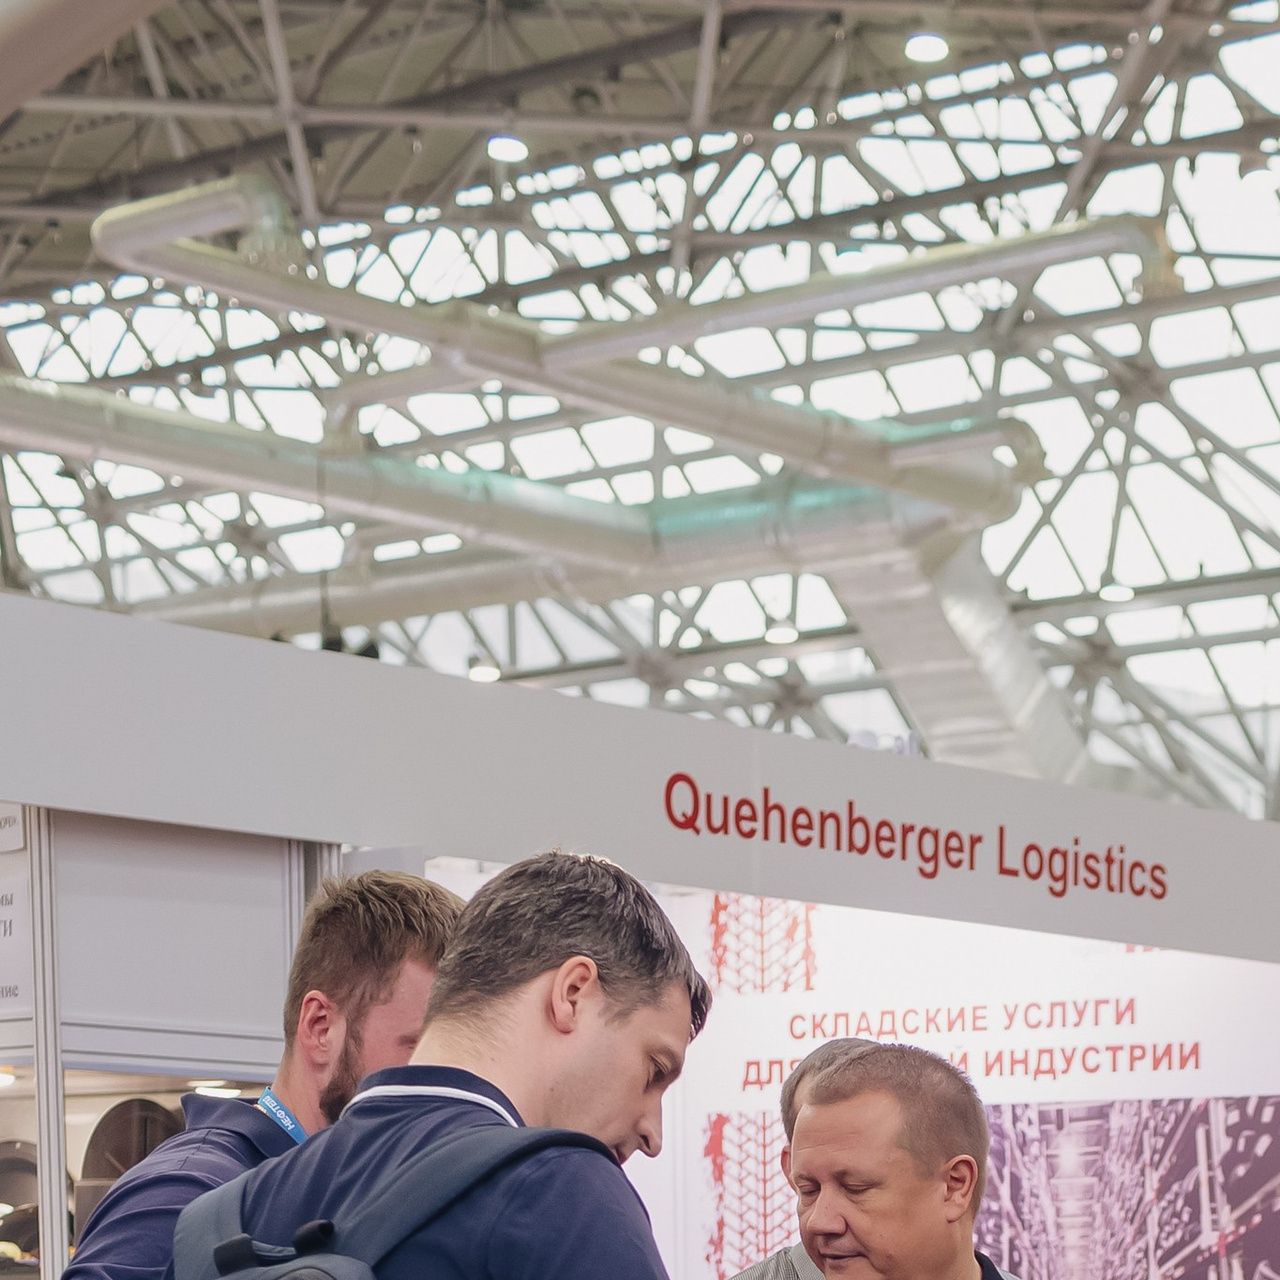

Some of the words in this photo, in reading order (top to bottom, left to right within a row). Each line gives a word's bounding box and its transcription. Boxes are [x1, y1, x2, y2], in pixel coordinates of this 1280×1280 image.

[664, 771, 983, 881] Quehenberger
[998, 824, 1169, 901] Logistics
[789, 1004, 988, 1041] СКЛАДСКИЕ
[1003, 997, 1137, 1032] УСЛУГИ
[984, 1041, 1201, 1081] ИНДУСТРИИ
